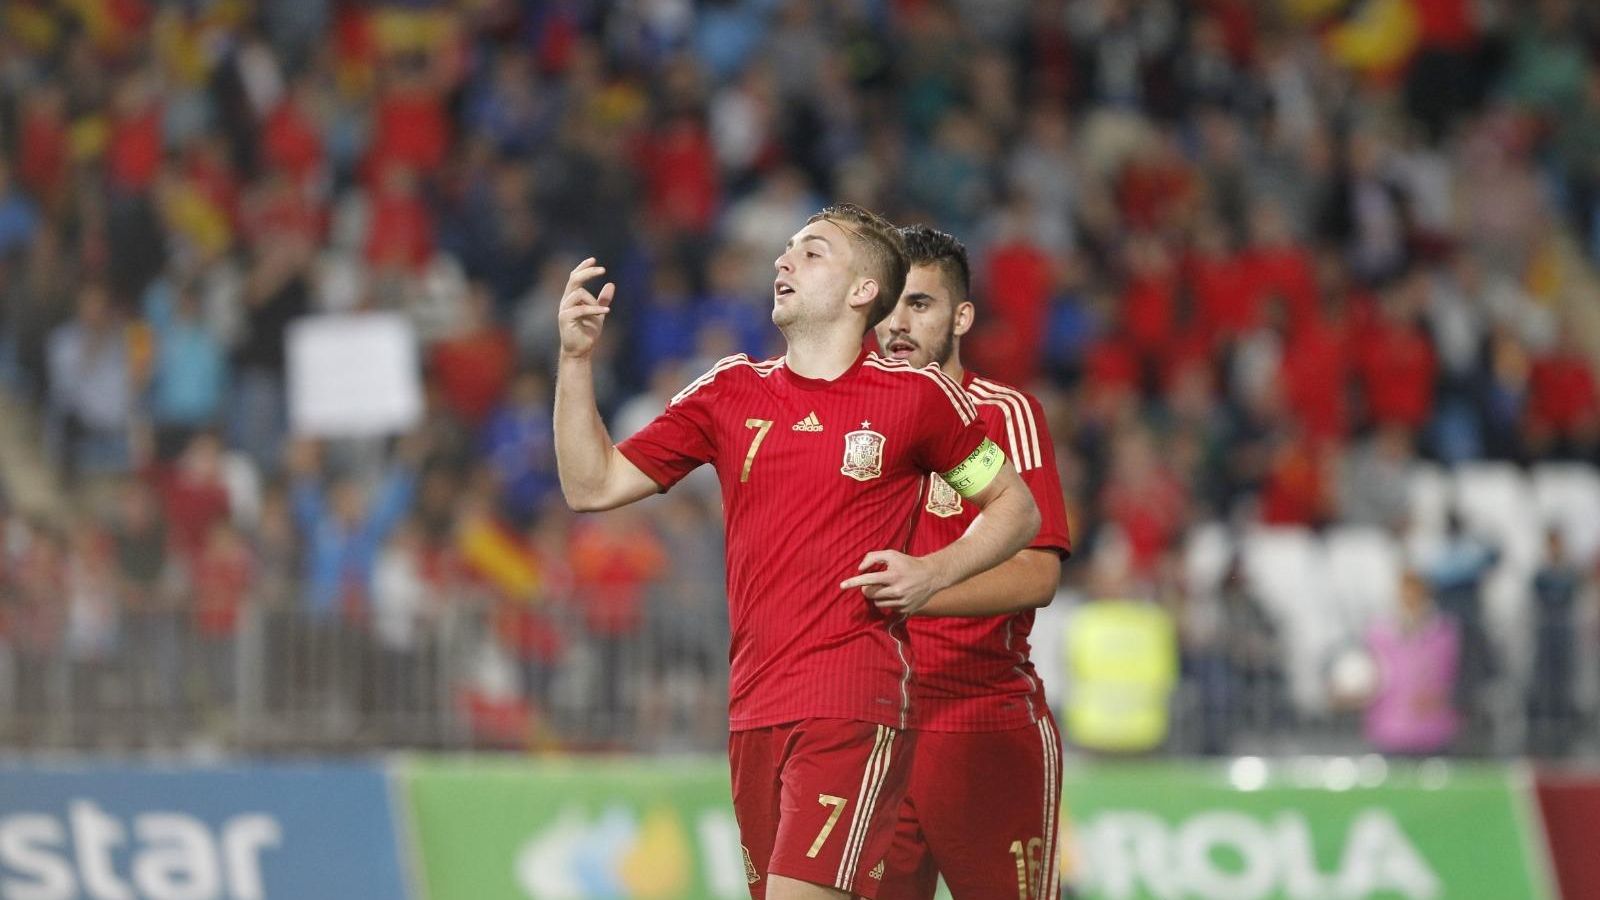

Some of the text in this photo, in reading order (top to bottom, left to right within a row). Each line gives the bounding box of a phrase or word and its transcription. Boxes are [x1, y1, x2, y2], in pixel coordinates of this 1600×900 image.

[741, 418, 774, 482] 7
[792, 424, 824, 432] adidas
[0, 799, 283, 900] star
[806, 794, 847, 858] 7
[1009, 837, 1044, 900] 16
